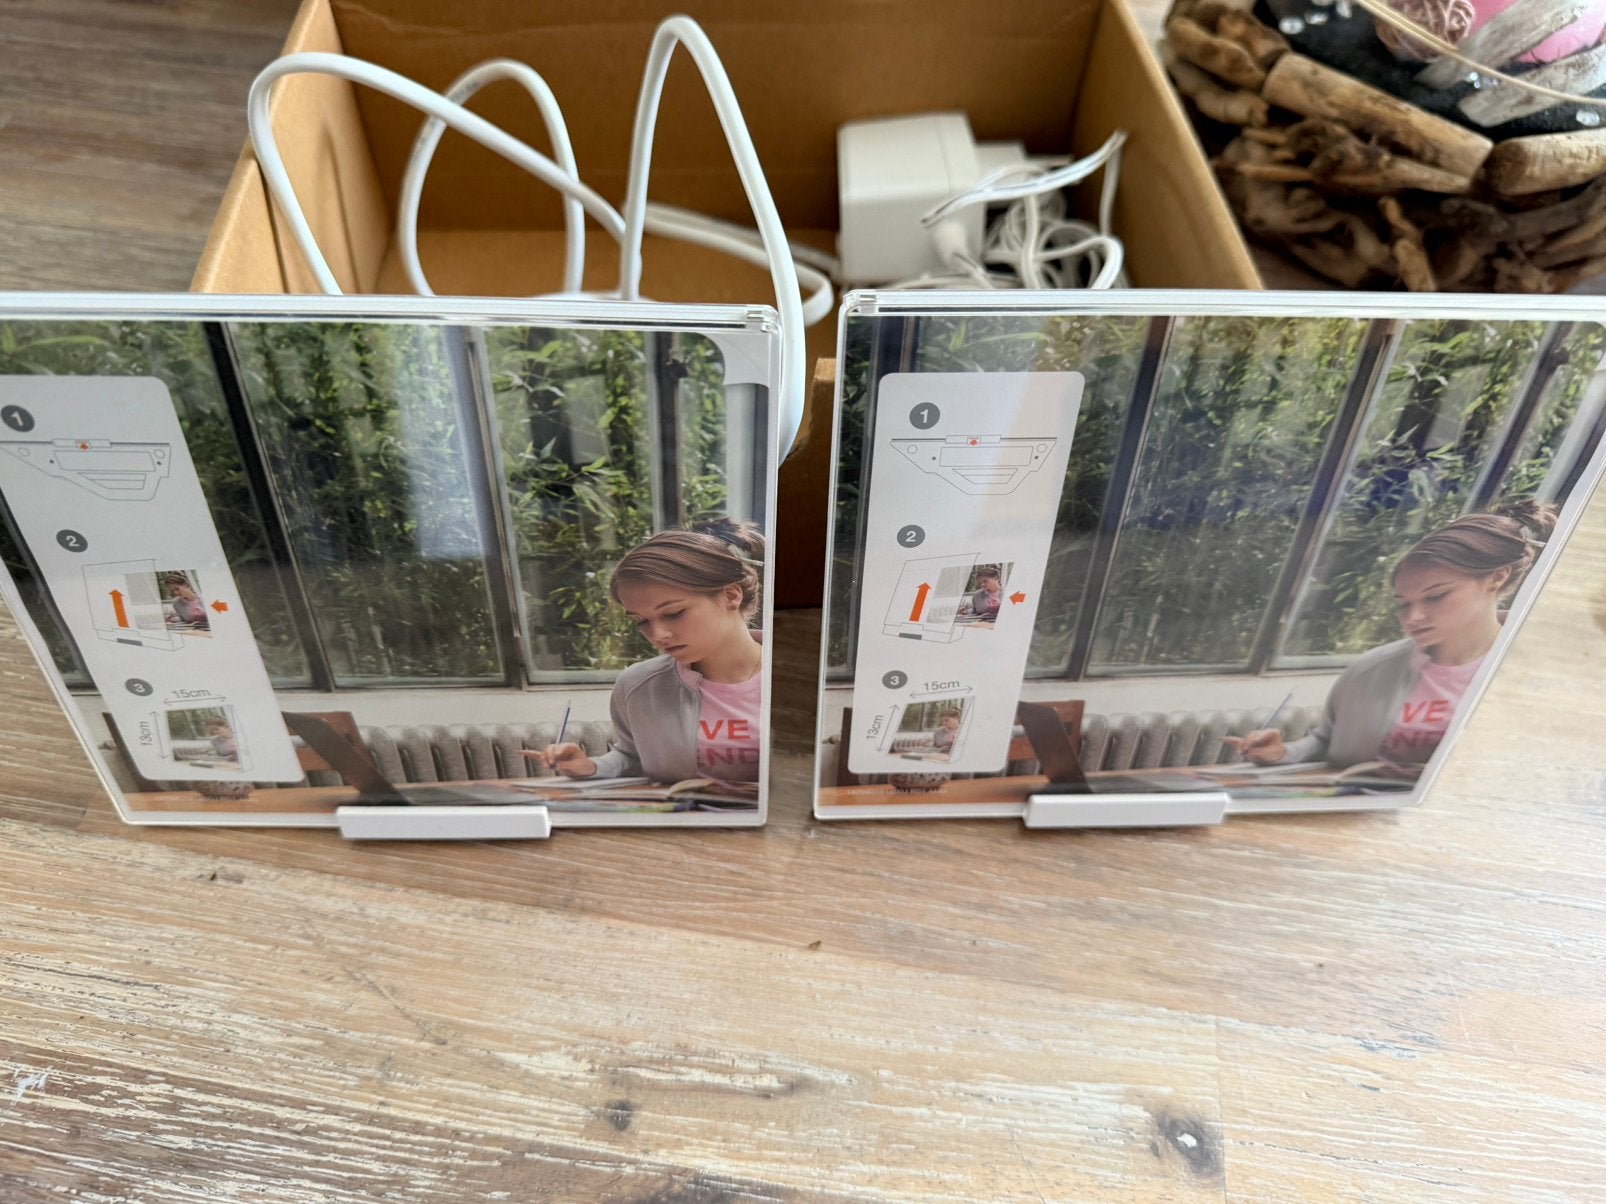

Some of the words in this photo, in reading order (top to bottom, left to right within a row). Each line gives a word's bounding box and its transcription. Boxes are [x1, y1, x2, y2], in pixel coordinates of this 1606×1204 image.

[171, 688, 212, 698] 15cm
[923, 680, 961, 691] 15cm
[139, 720, 153, 746] 13cm
[866, 714, 885, 740] 13cm
